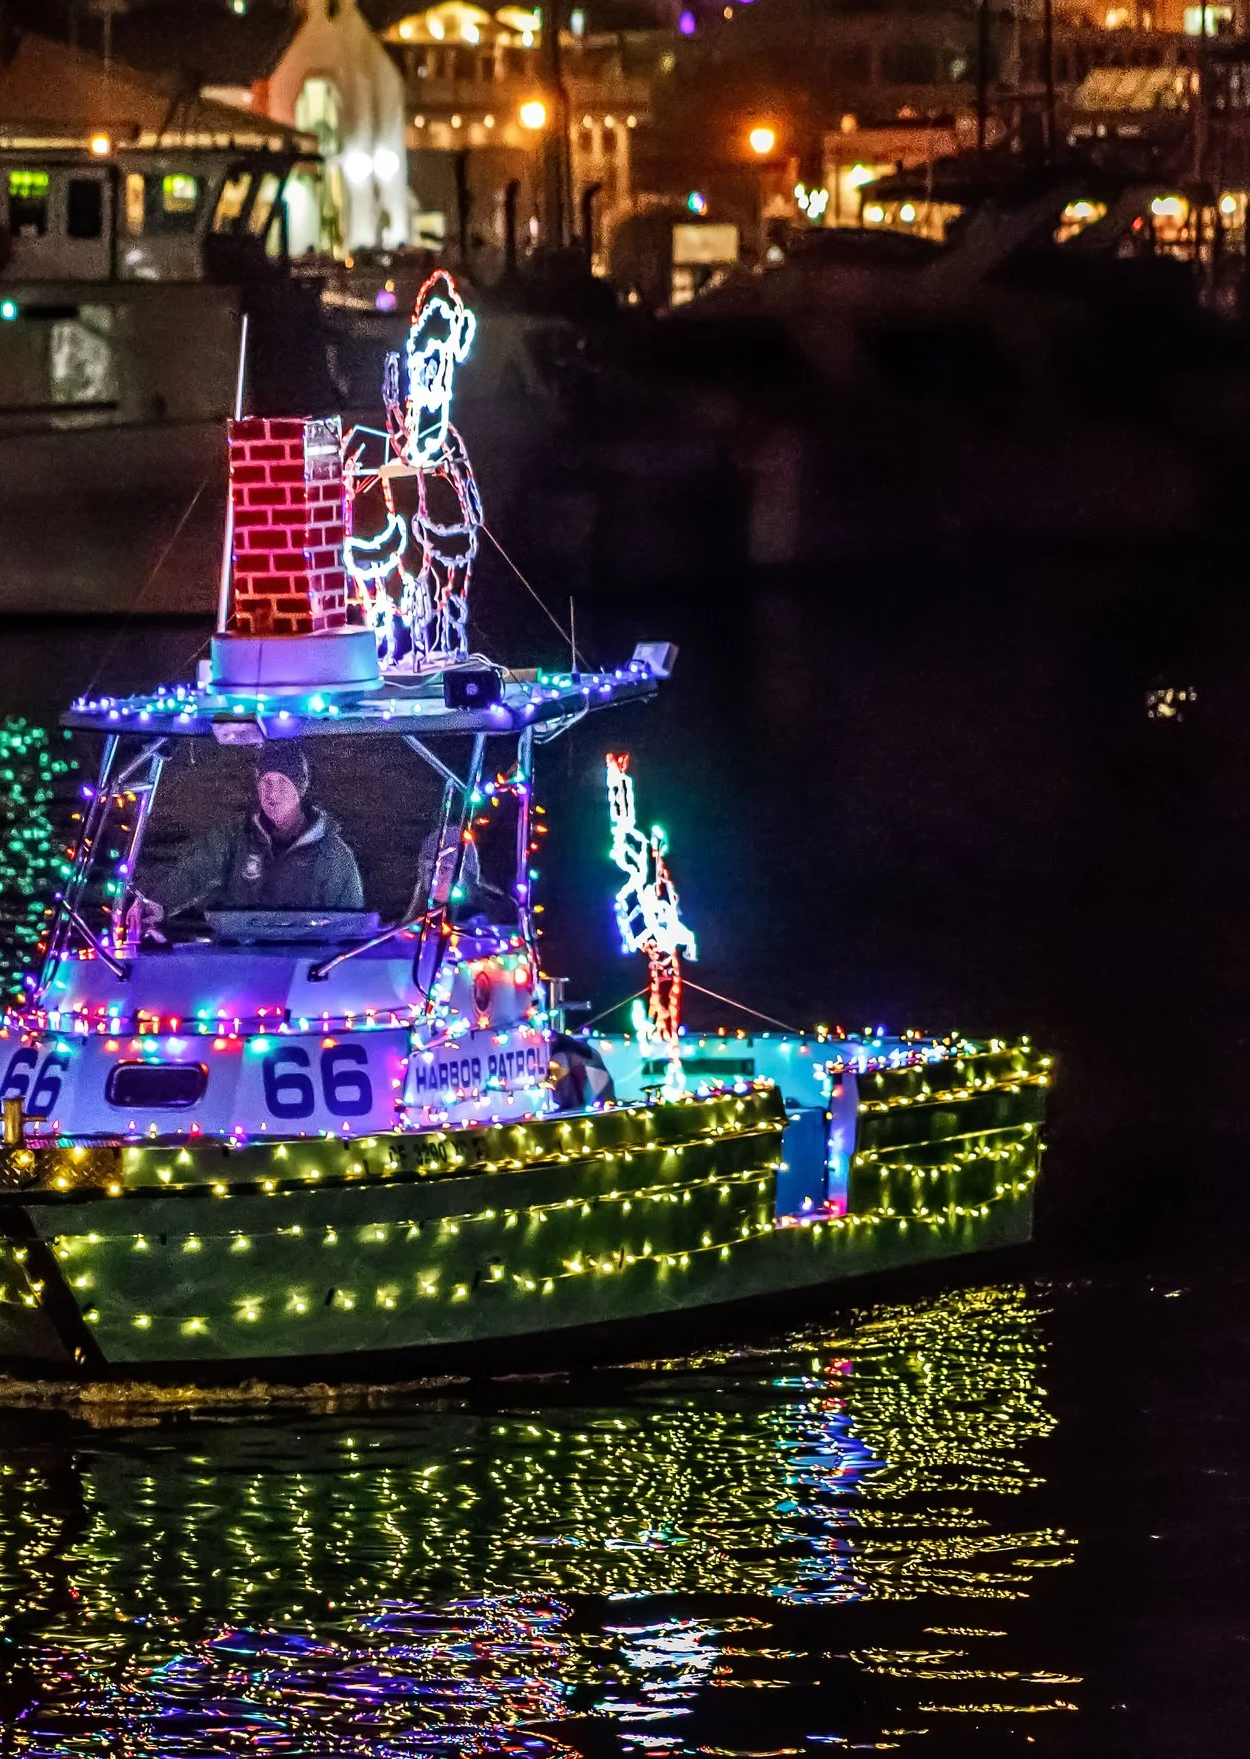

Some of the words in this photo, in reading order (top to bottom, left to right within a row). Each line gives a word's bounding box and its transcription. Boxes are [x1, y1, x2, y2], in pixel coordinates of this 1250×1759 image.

[262, 1044, 373, 1119] 66
[416, 1057, 481, 1094] HARBOR
[487, 1048, 545, 1082] PATROL
